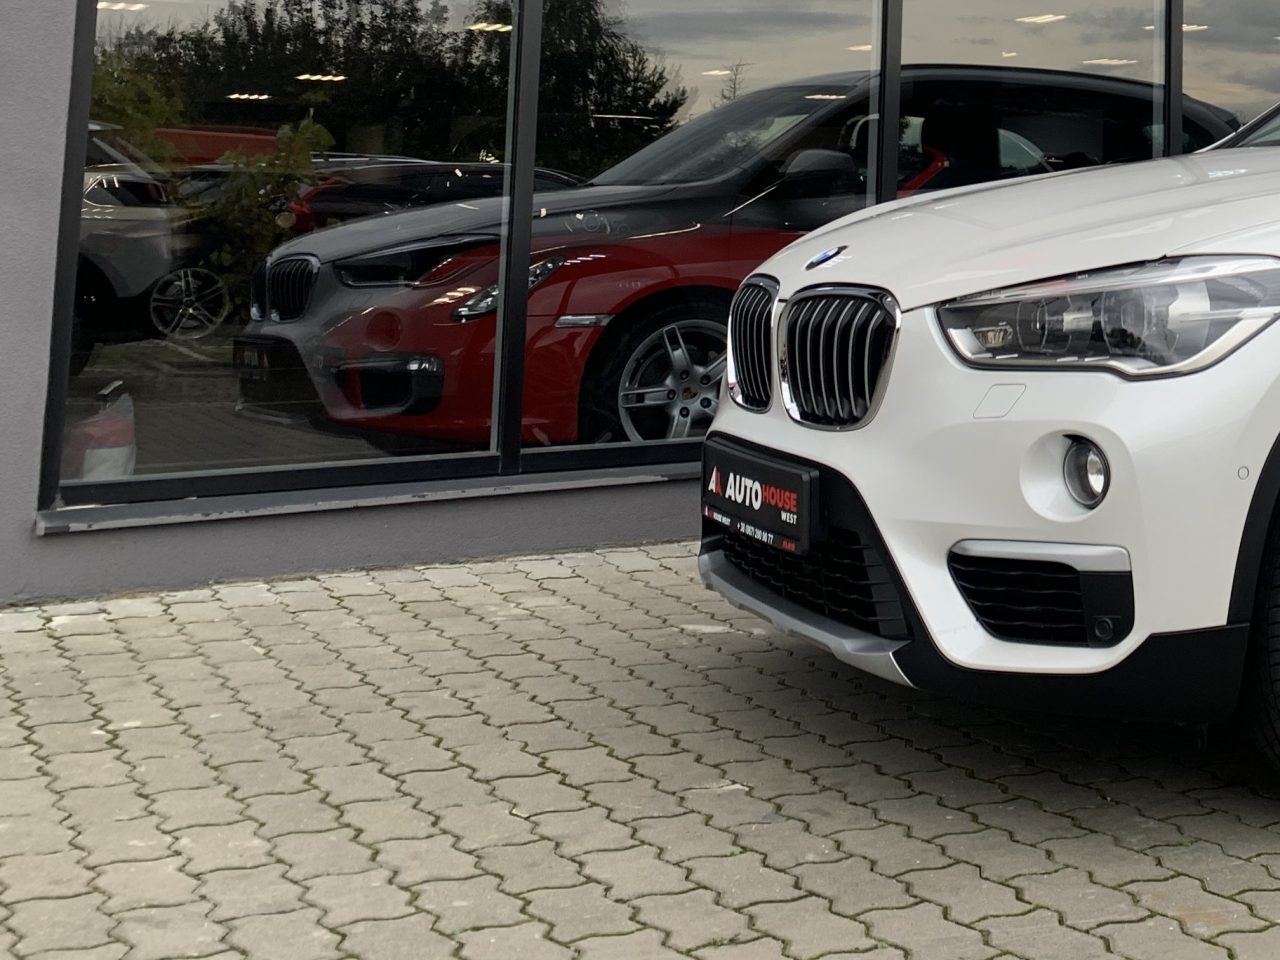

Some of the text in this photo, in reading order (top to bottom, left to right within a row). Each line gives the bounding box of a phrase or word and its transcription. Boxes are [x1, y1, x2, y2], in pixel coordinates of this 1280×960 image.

[725, 472, 762, 510] AUTO
[762, 484, 797, 513] HOUSE
[781, 510, 797, 525] WEST
